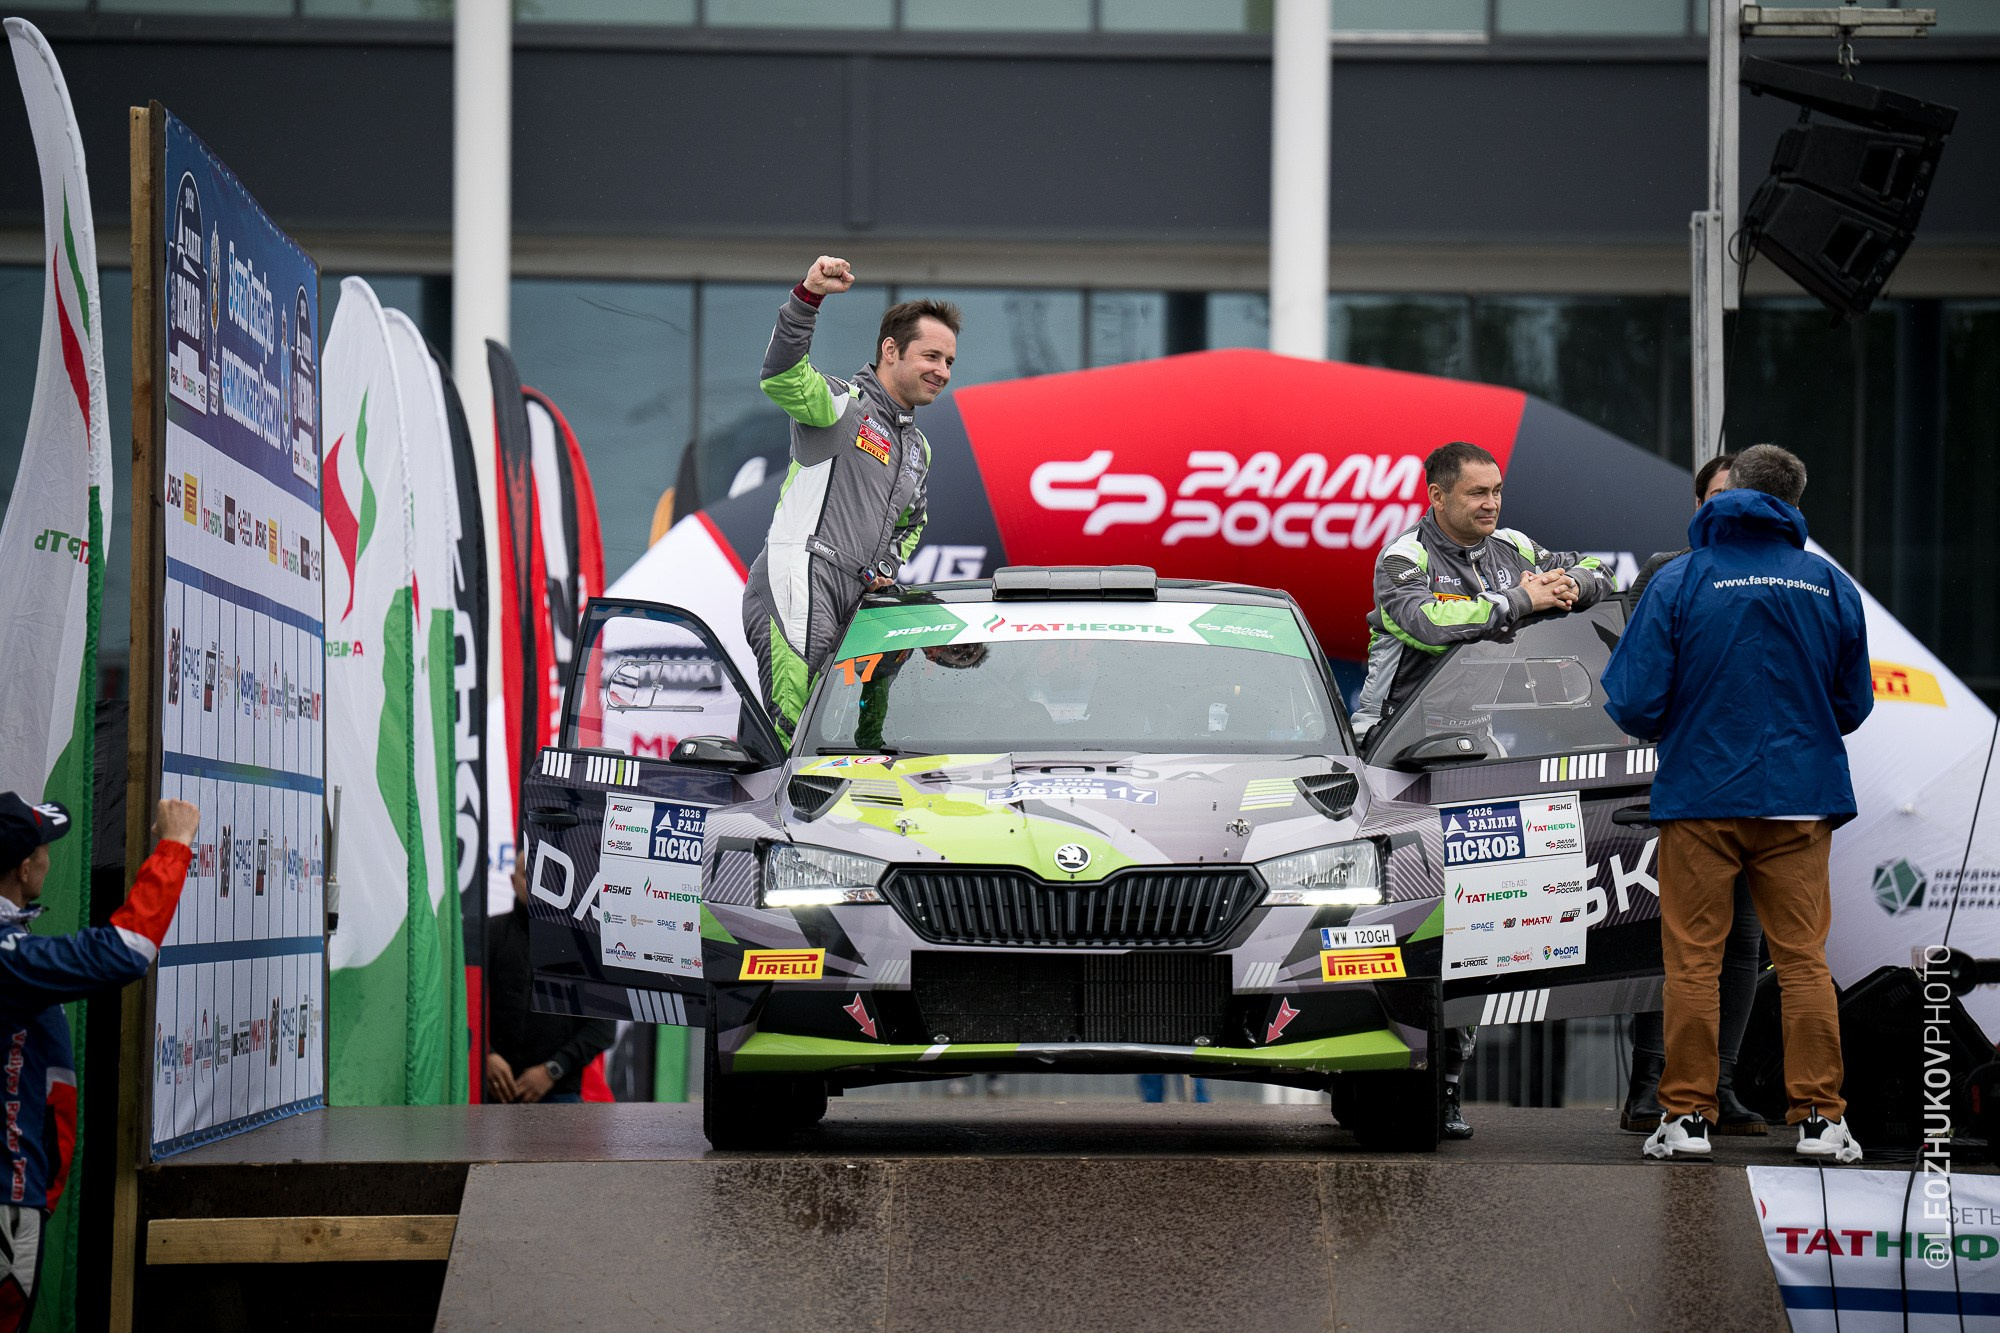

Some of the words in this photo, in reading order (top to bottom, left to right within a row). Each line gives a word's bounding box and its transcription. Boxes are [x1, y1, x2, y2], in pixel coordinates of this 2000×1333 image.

[177, 273, 200, 340] ПСКОВ
[1177, 450, 1423, 499] РАЛЛИ
[1162, 500, 1423, 549] РОССИ
[1713, 575, 1830, 597] www.faspo.pskov.ru
[1010, 623, 1174, 634] ТАТНЕФТЬ
[834, 653, 884, 685] 17
[1112, 787, 1153, 802] 17
[679, 808, 701, 819] 2026
[1467, 807, 1492, 818] 2026
[614, 823, 649, 834] ТАТНЕФТЬ
[1468, 815, 1518, 831] РАЛЛИ
[1533, 822, 1576, 832] ТАТНЕФТЬ
[654, 836, 703, 862] ПСКО
[1447, 835, 1520, 863] ПСКОВ
[1501, 881, 1516, 889] СЕТЬ
[1516, 879, 1528, 887] АЗС
[1555, 886, 1582, 894] РОССИИ
[1557, 880, 1580, 888] РАЛЛИ
[652, 890, 702, 904] ТАТНЕФТЬ
[1465, 889, 1528, 904] ТАТНЕФТЬ
[657, 920, 677, 928] SPACE
[1471, 922, 1495, 930] SPACE
[1333, 932, 1347, 945] WW
[1355, 930, 1390, 944] 120GH
[1553, 945, 1578, 957] ФЬОРД
[747, 954, 818, 974] PIRELLI
[1327, 953, 1397, 976] PIRELLI
